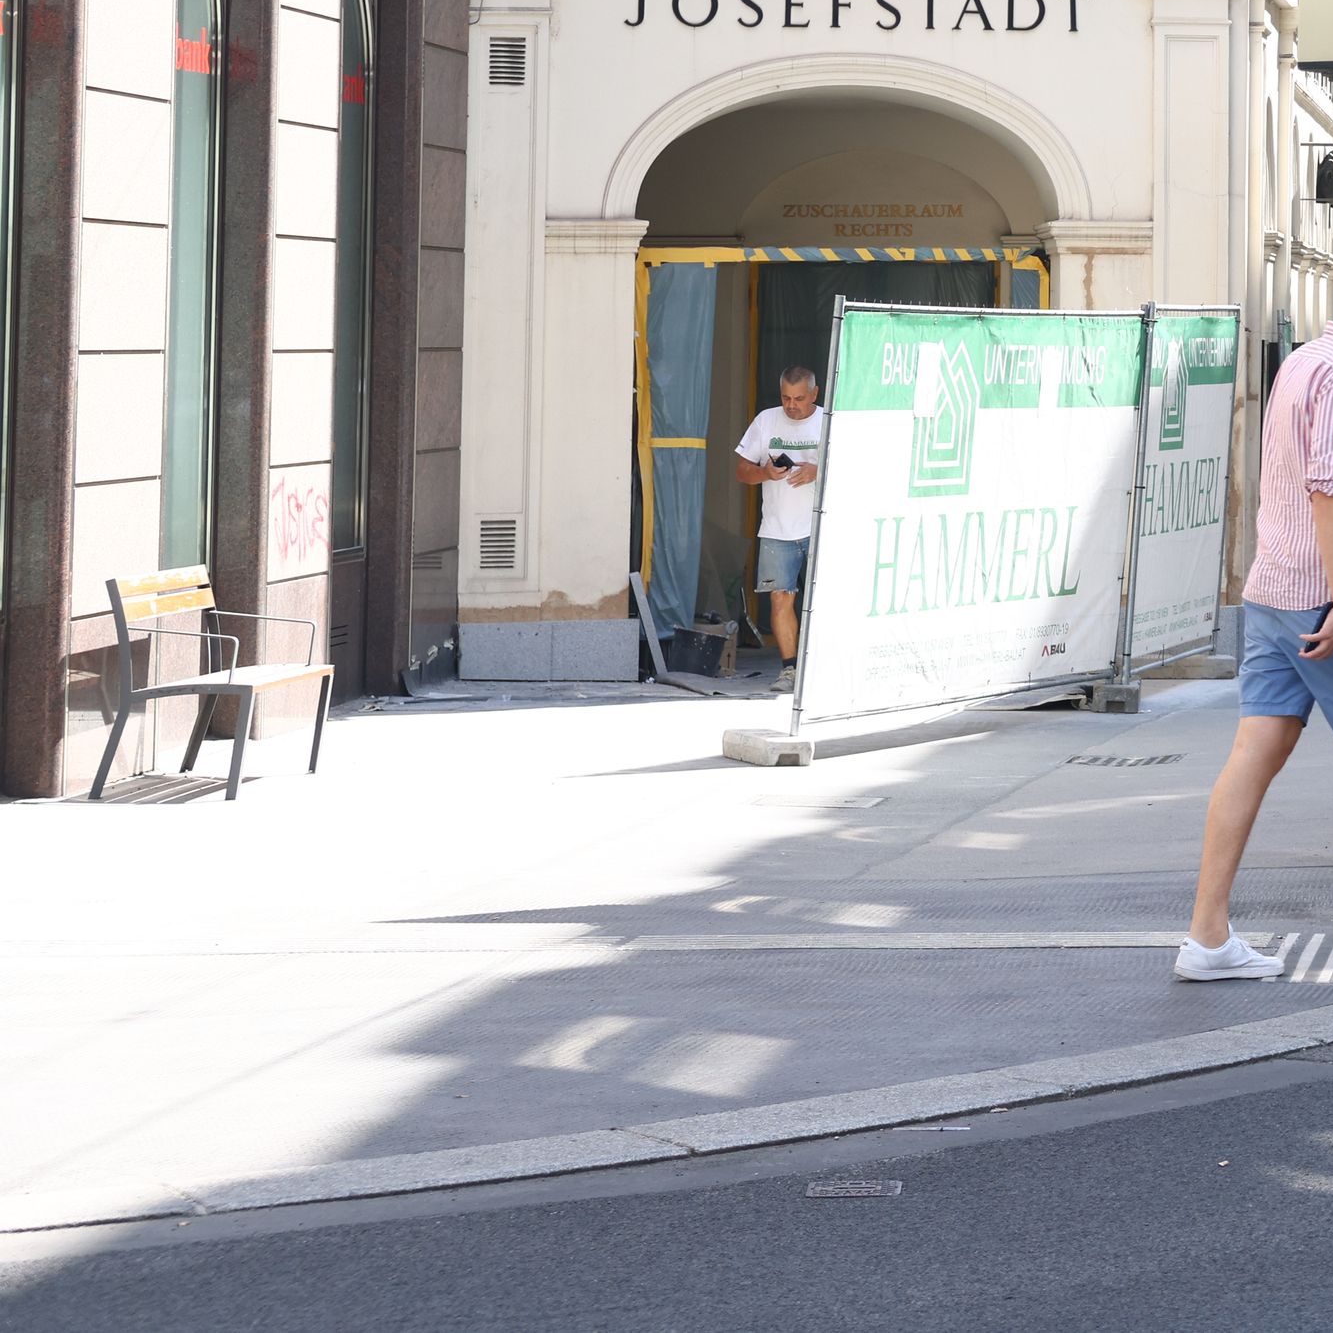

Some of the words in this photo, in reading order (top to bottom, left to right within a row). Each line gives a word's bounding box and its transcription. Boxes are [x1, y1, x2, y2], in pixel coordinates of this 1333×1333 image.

[783, 204, 964, 218] ZUSCHAUERRAUM
[833, 223, 914, 238] RECHTS
[881, 342, 919, 385] BAU
[983, 343, 1108, 385] UNTERNMUNG
[1141, 457, 1221, 537] HAMMERL
[866, 506, 1081, 617] HAMMERL
